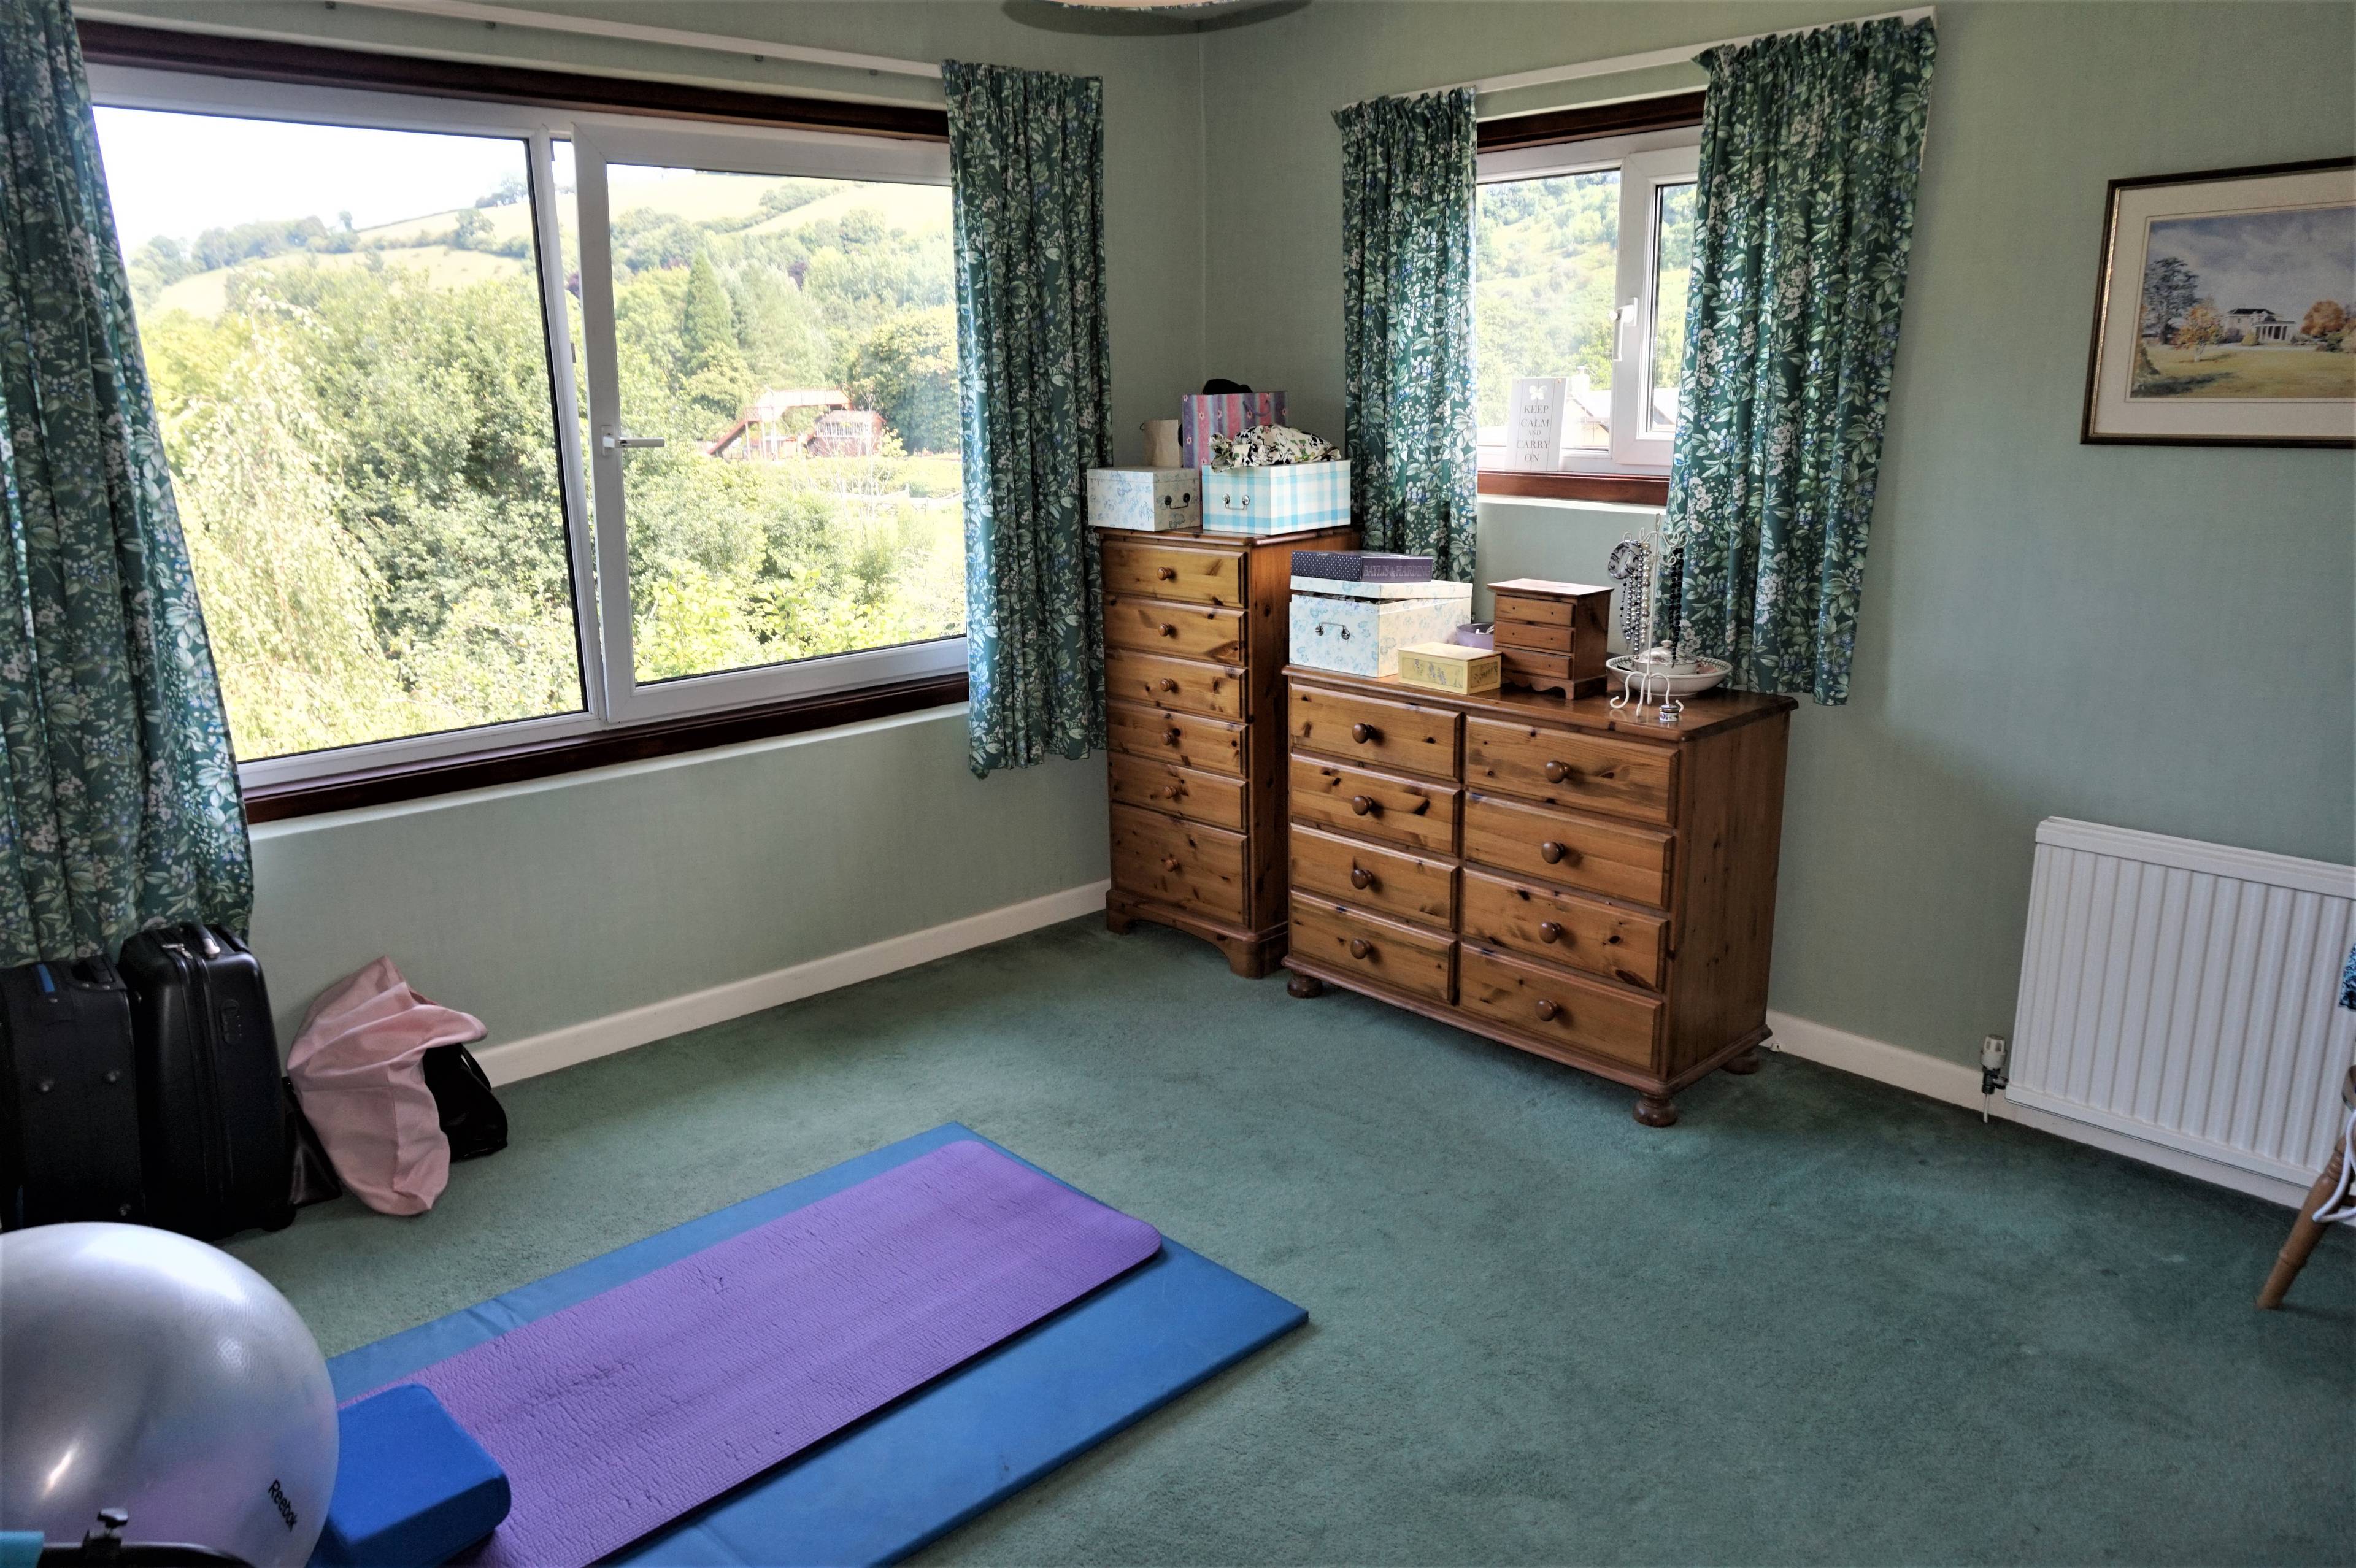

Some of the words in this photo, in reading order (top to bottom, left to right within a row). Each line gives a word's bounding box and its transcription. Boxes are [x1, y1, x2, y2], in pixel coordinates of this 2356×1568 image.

[1524, 405, 1549, 413] KEEP
[1520, 418, 1549, 427] CALM
[1516, 440, 1550, 449] CARRY
[1363, 565, 1389, 576] BAYLIS
[268, 1478, 298, 1532] Reebok
